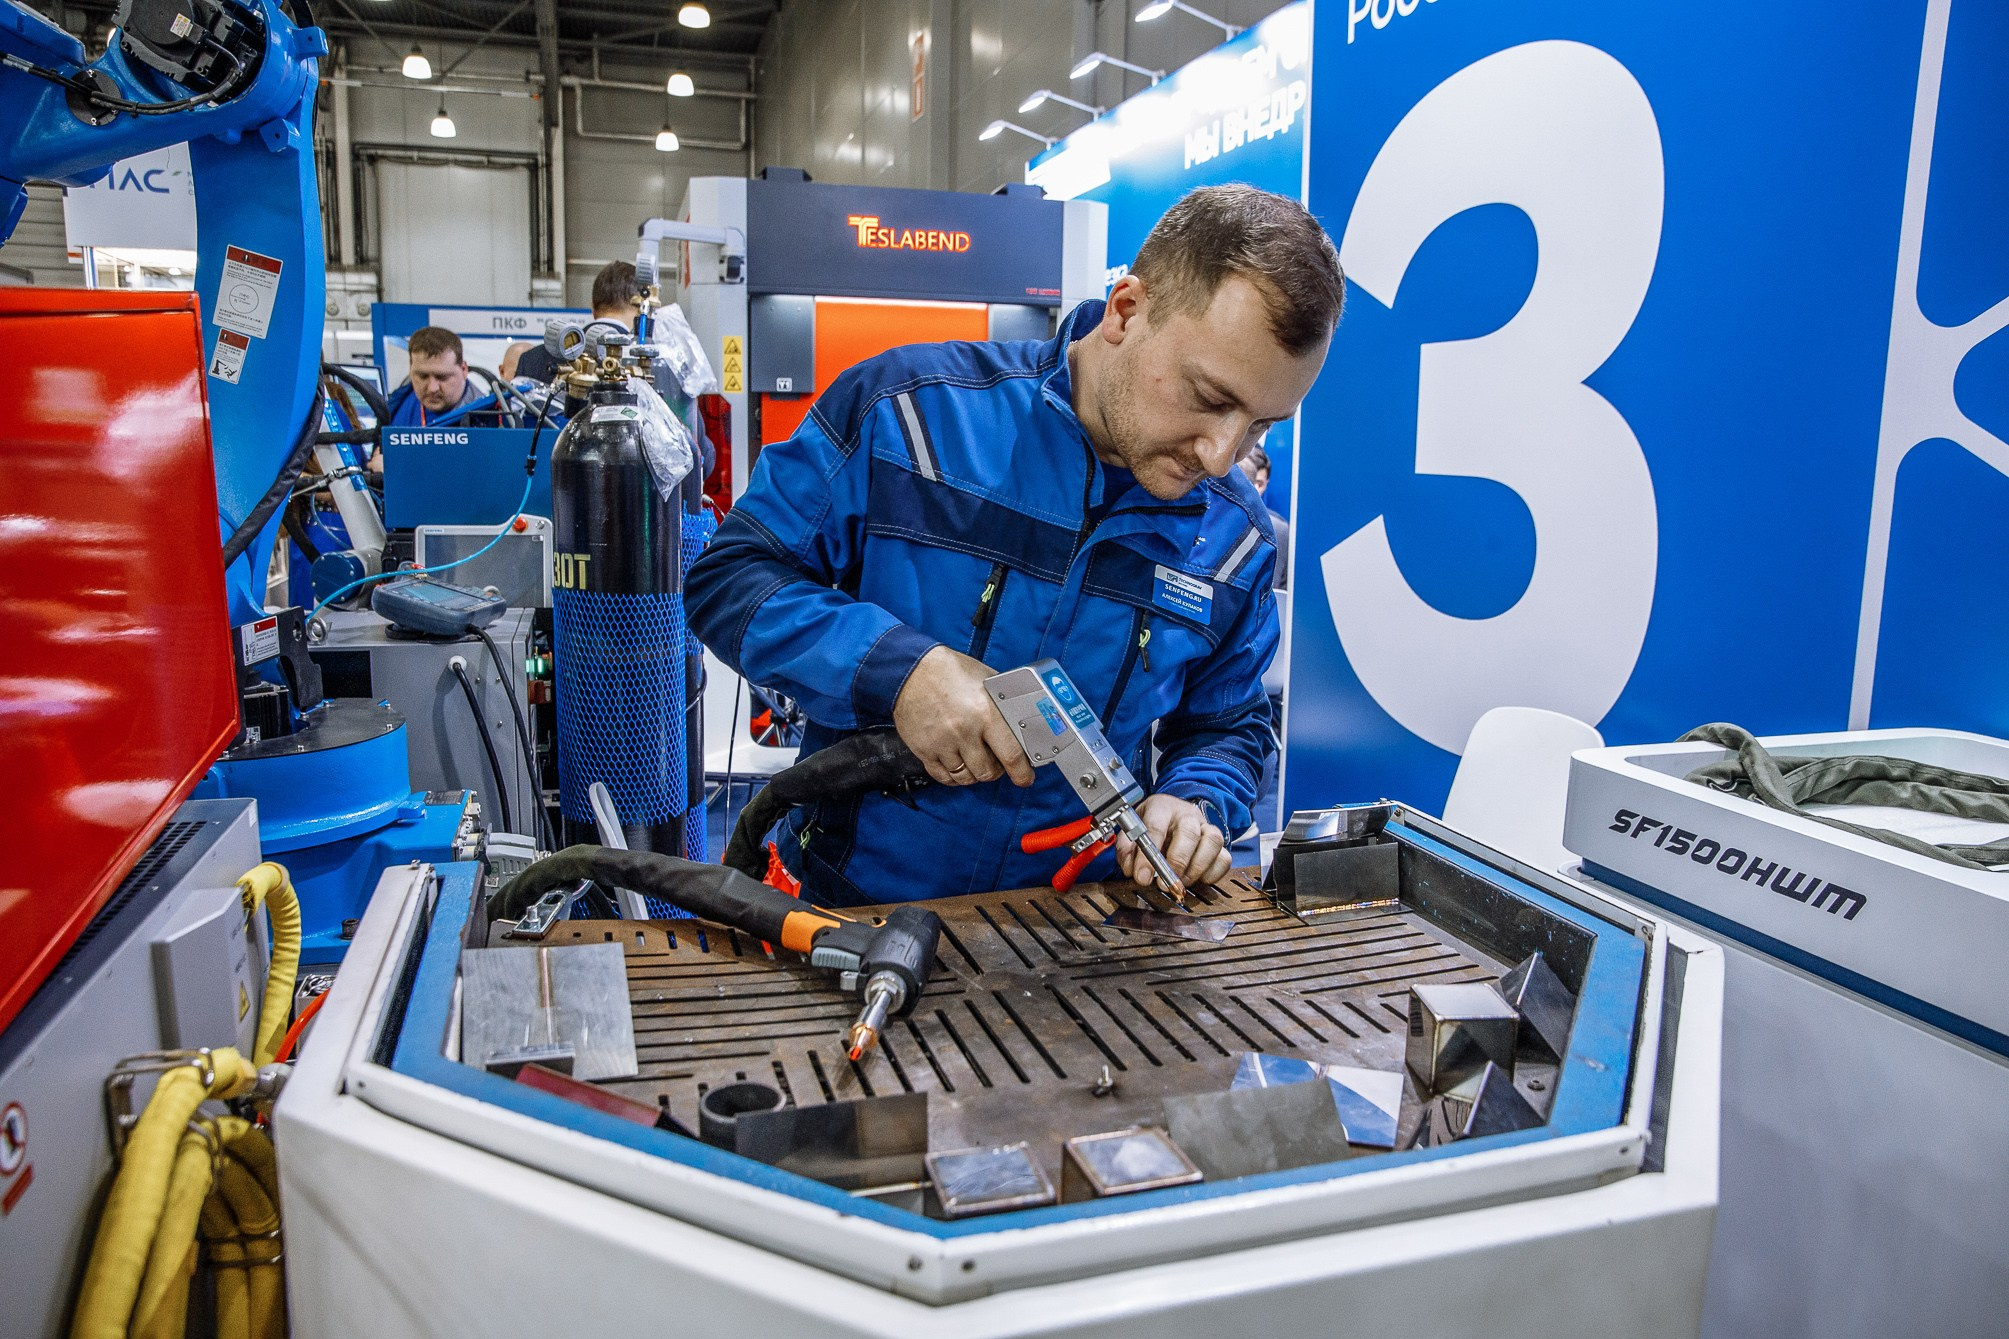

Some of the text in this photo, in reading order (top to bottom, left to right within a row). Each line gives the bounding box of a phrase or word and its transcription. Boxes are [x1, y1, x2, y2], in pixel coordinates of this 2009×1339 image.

[1184, 80, 1306, 170] МЫ ВНЕДР
[848, 215, 971, 252] TESLABEND
[493, 317, 527, 329] ПКФ
[389, 432, 469, 446] SENFENG
[1608, 808, 1867, 921] SF1500HWM
